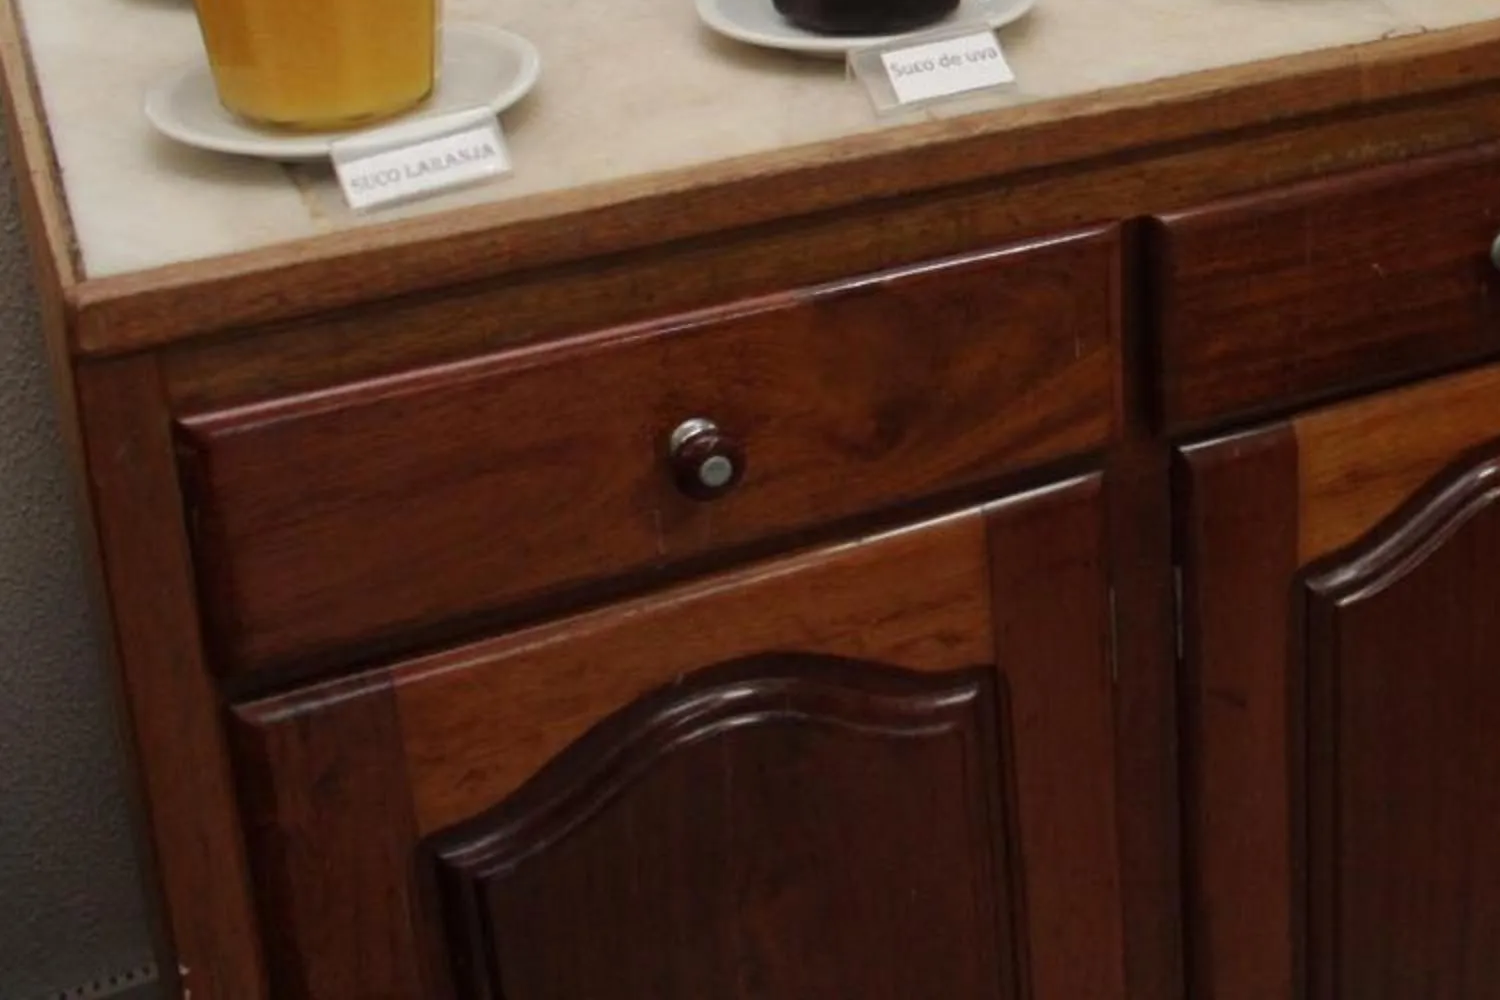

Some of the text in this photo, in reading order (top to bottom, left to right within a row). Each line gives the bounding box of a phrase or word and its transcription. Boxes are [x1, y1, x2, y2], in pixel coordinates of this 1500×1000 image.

[889, 46, 999, 77] Suco de uva
